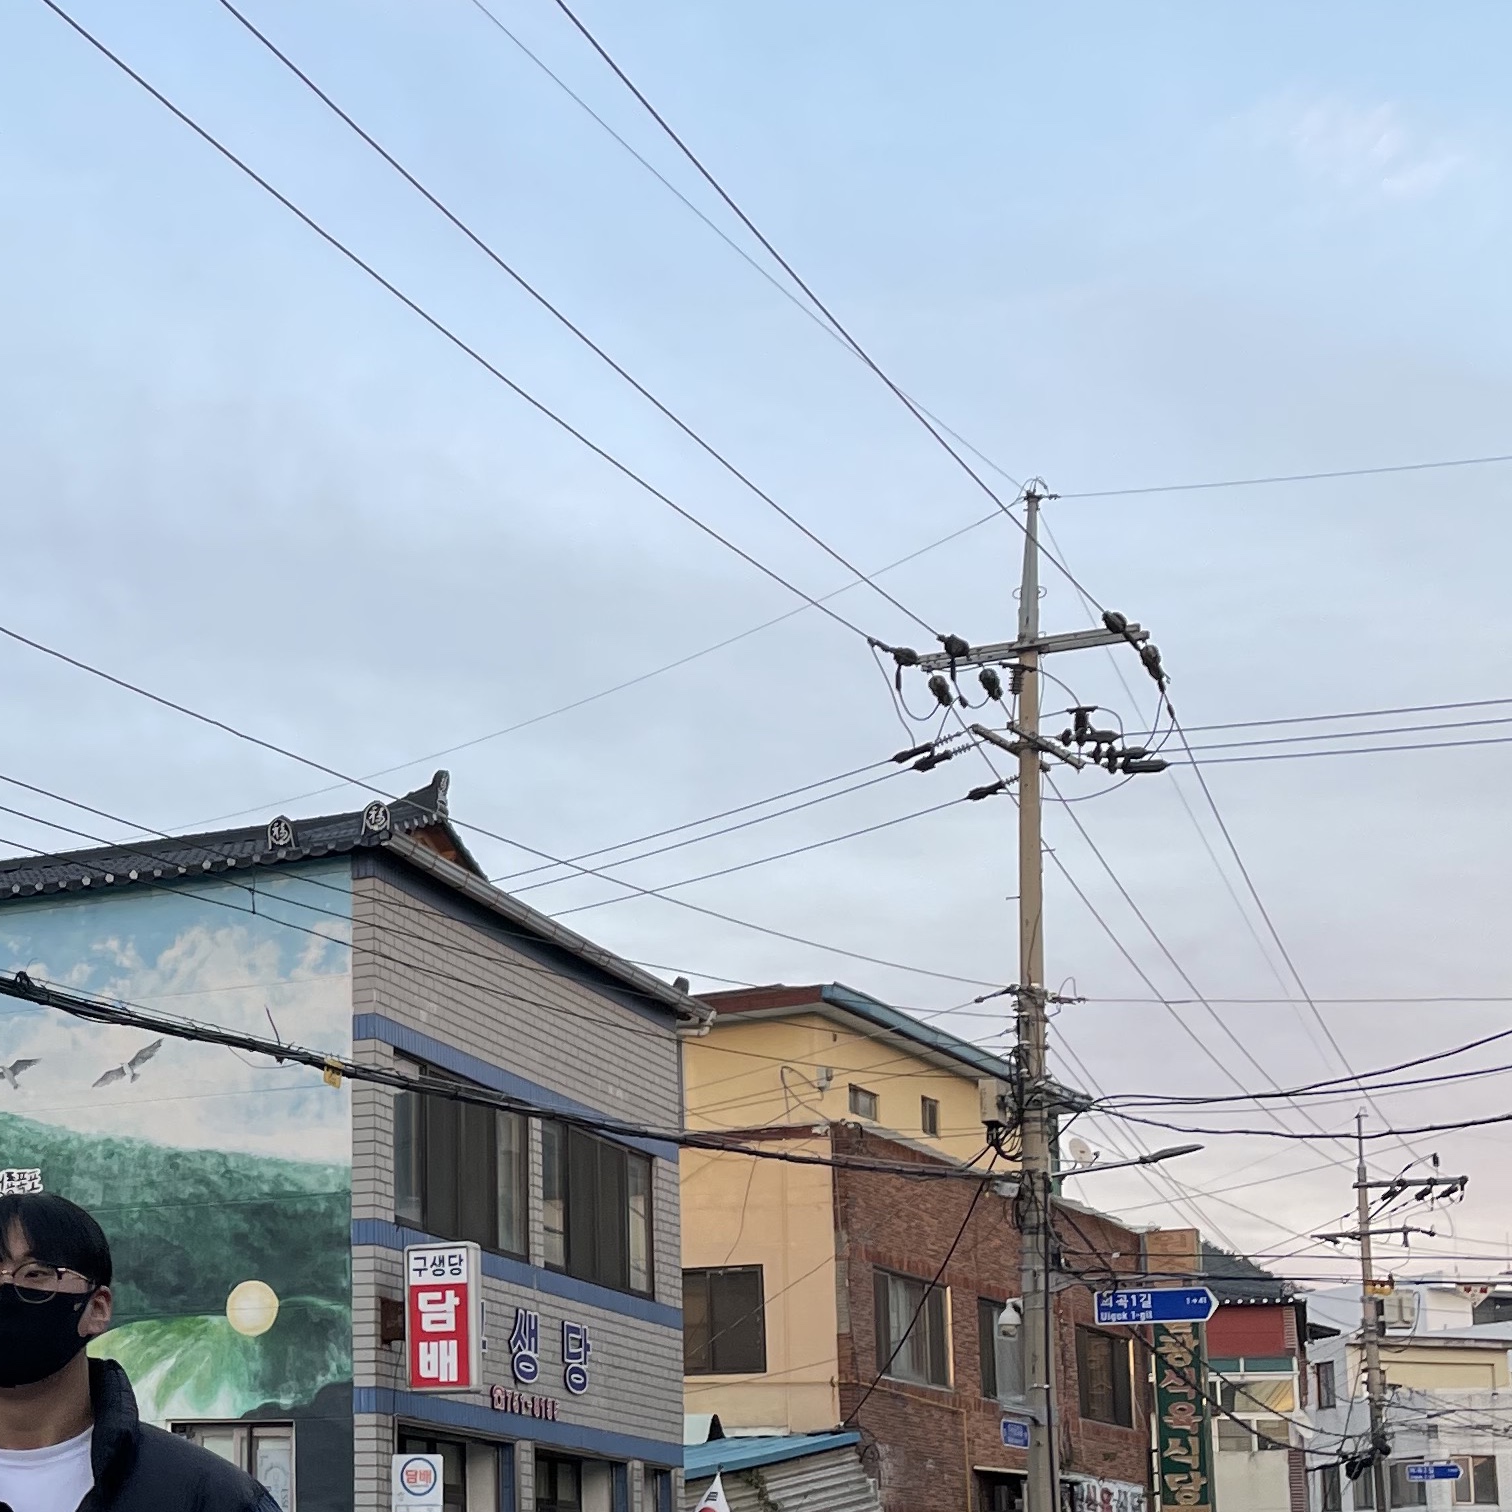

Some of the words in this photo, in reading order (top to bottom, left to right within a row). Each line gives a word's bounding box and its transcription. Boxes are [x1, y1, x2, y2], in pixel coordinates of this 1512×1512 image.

[412, 1254, 464, 1277] 구생당
[417, 1290, 460, 1382] 담배
[479, 1300, 592, 1395] 생당
[405, 1469, 432, 1484] 담배
